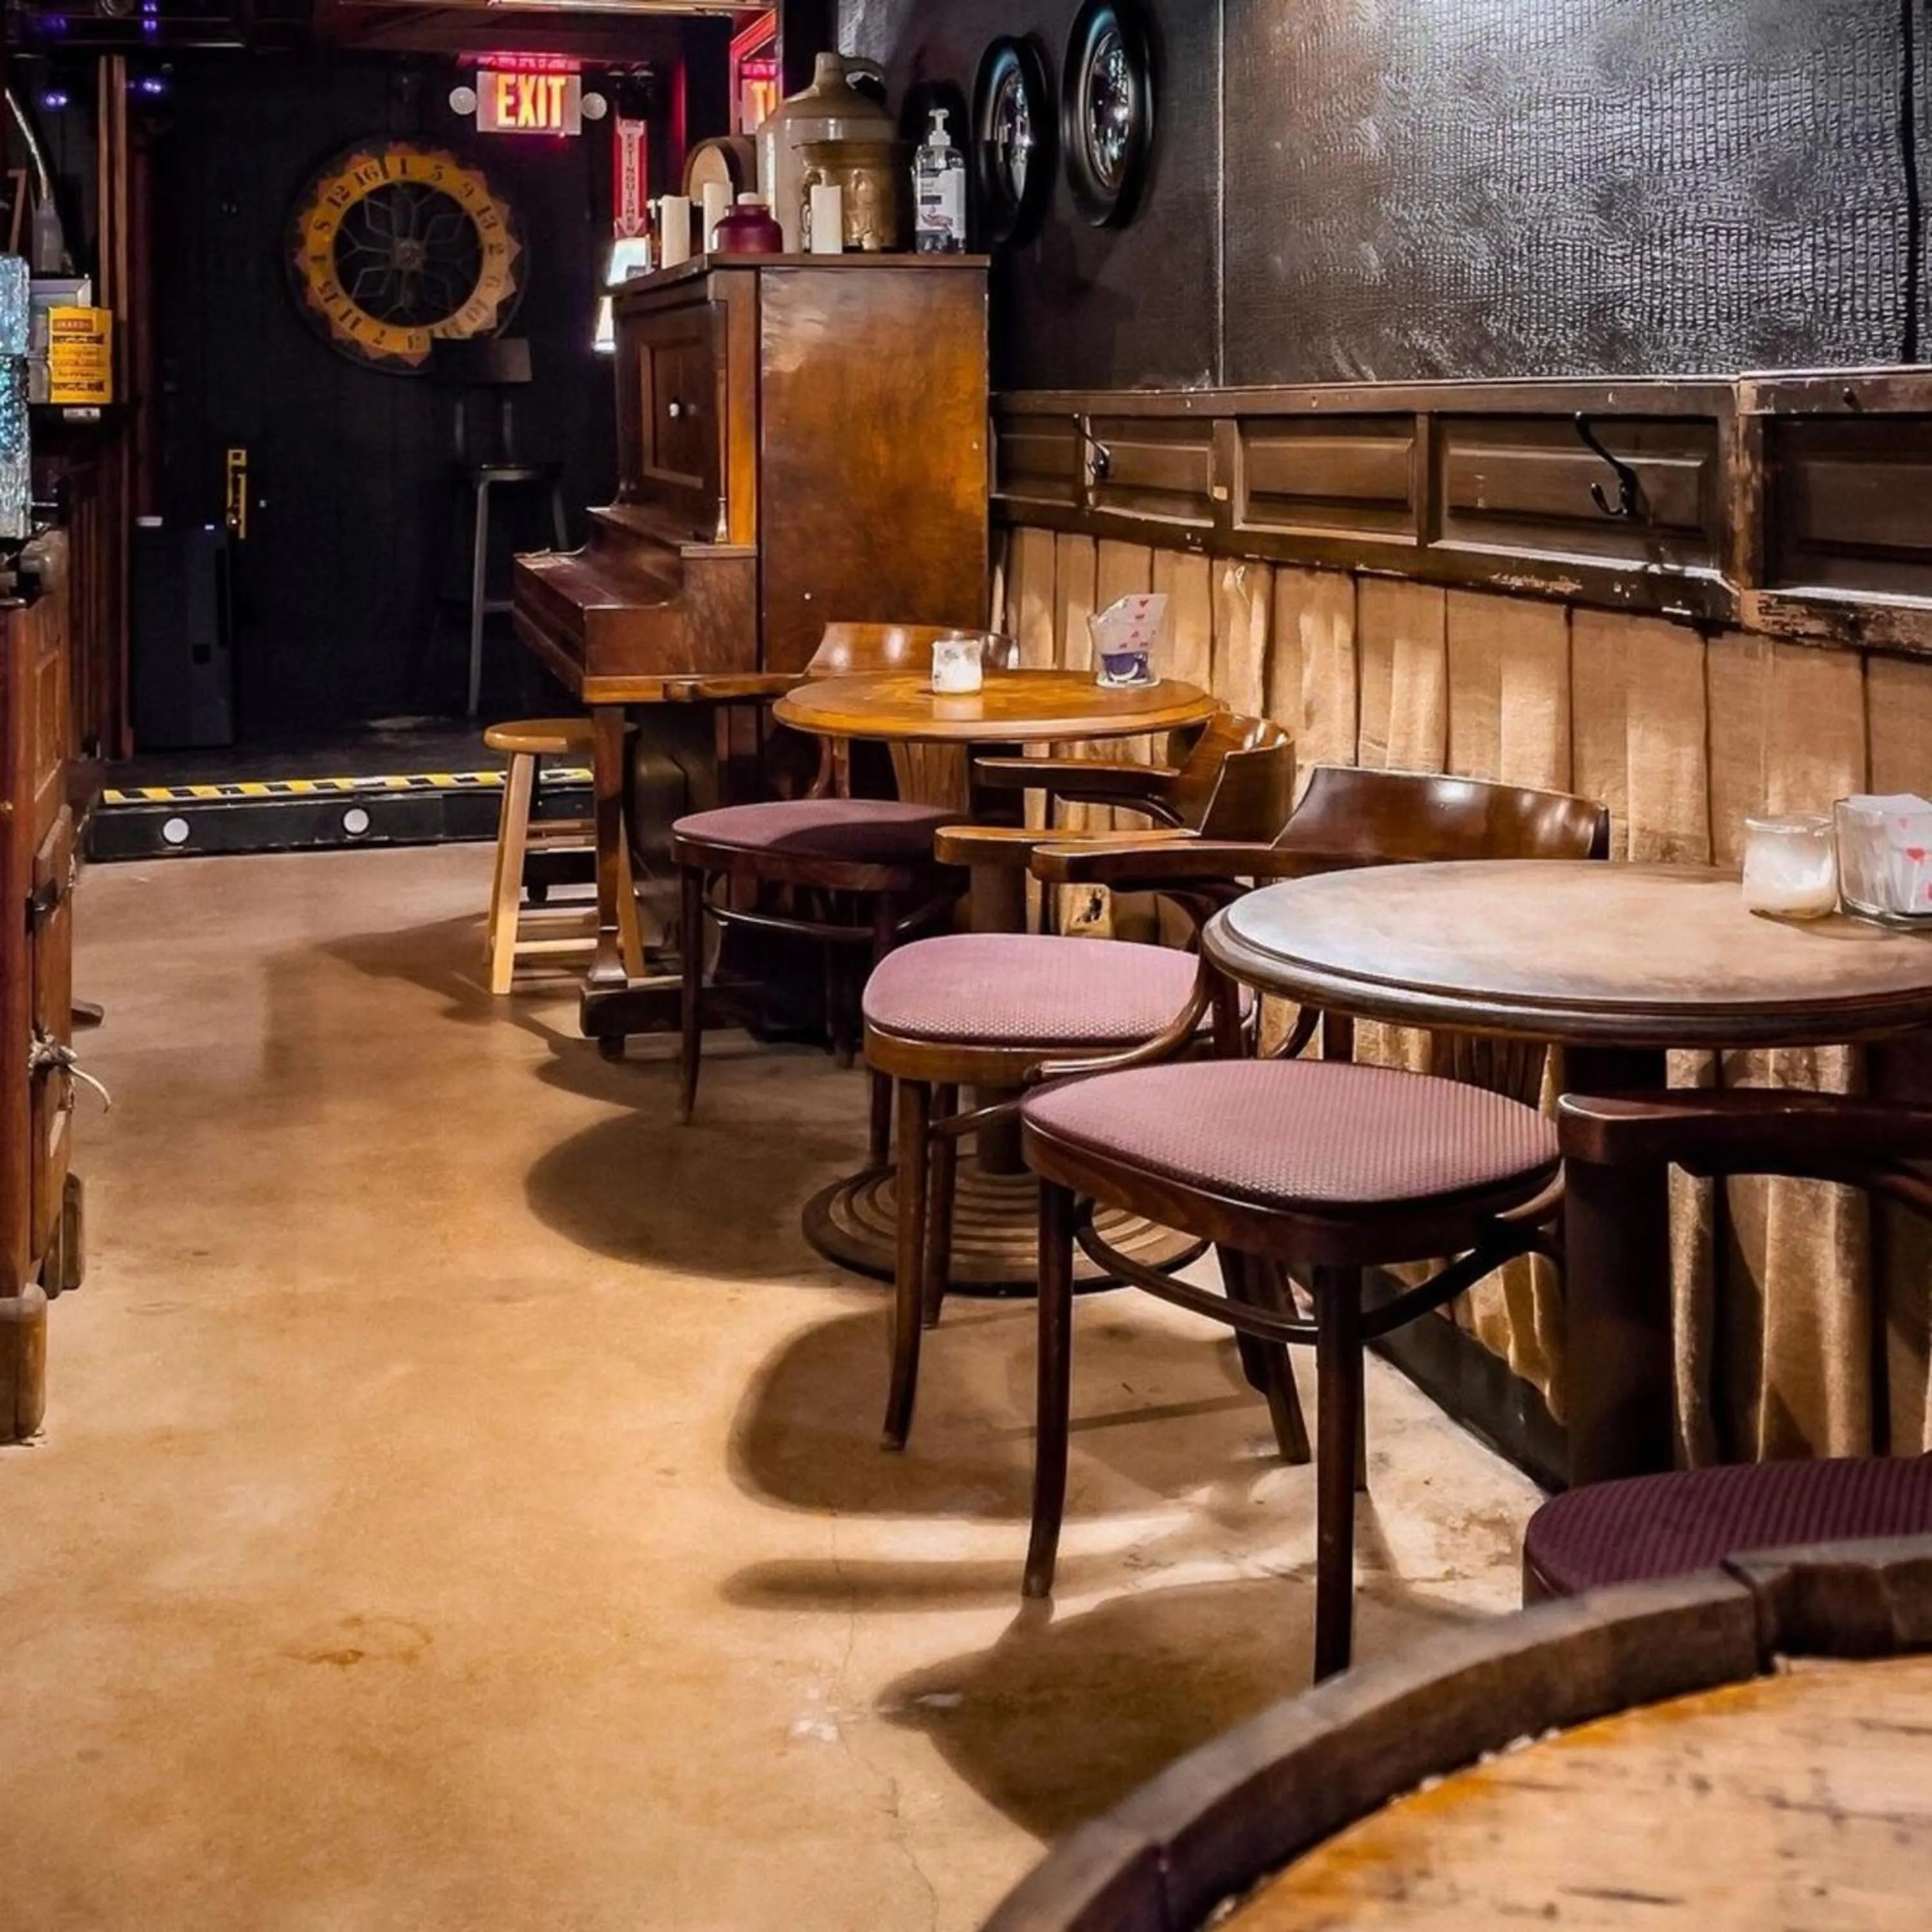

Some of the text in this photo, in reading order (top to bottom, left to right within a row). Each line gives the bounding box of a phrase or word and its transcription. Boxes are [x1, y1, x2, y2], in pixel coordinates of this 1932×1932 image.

[497, 73, 567, 128] EXIT
[354, 166, 379, 187] 16
[399, 157, 408, 175] 1
[430, 164, 444, 182] 5
[327, 185, 350, 208] 12
